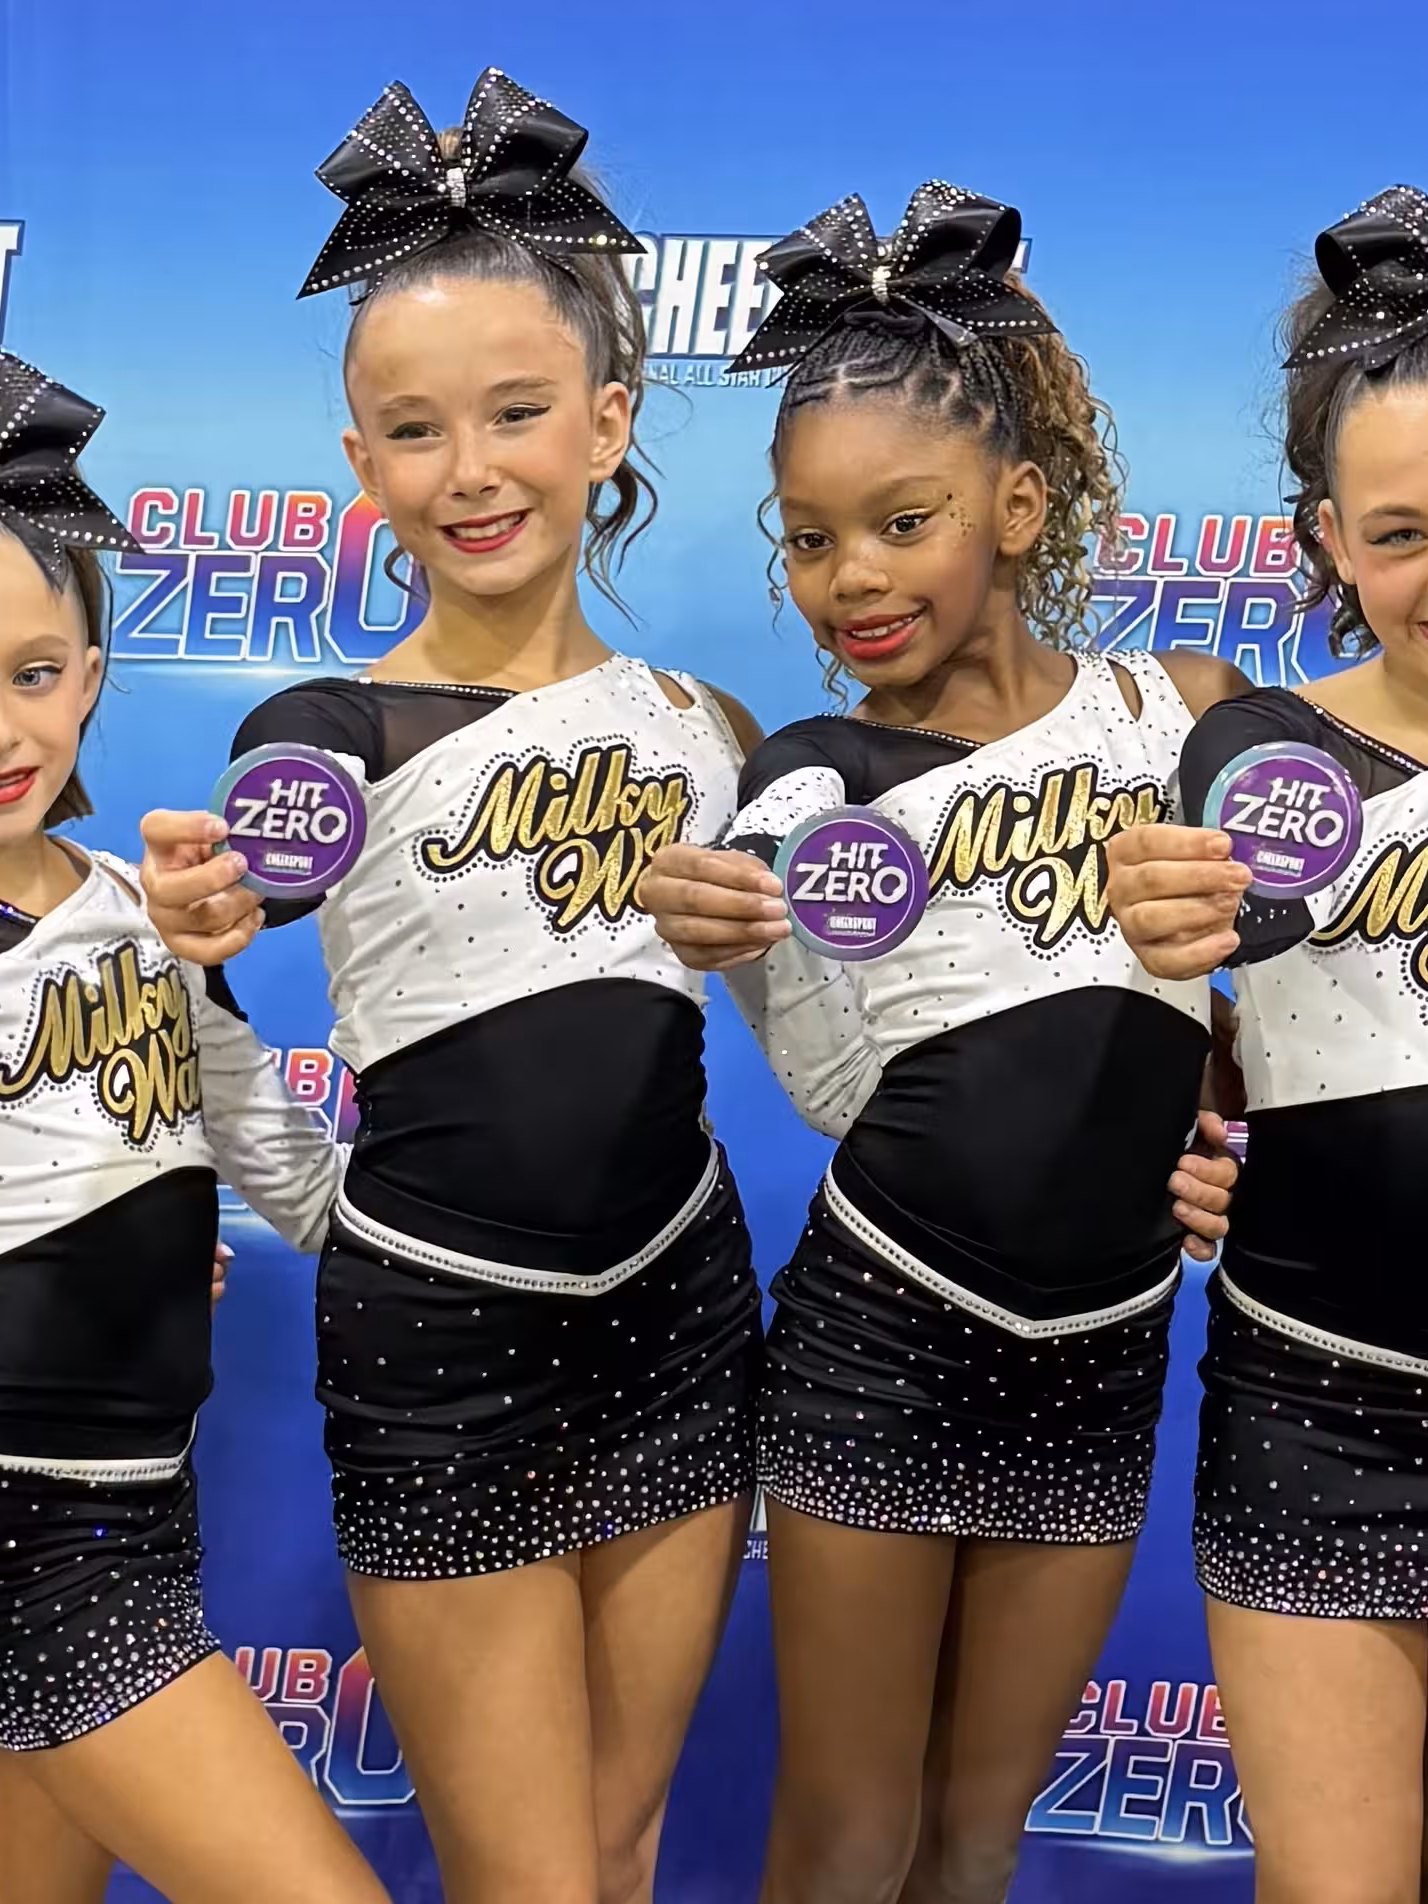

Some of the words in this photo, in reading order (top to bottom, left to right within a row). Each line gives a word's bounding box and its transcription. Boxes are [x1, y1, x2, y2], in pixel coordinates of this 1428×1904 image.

[126, 487, 333, 552] CLUB
[1093, 512, 1302, 578] CLUB
[270, 778, 331, 809] HIT
[425, 747, 689, 868] Milky
[1268, 777, 1332, 811] HIT
[229, 797, 348, 845] ZERO
[1223, 792, 1345, 848] ZERO
[829, 841, 889, 870] HIT
[791, 862, 908, 904] ZERO
[1024, 1733, 1256, 1846] ZER
